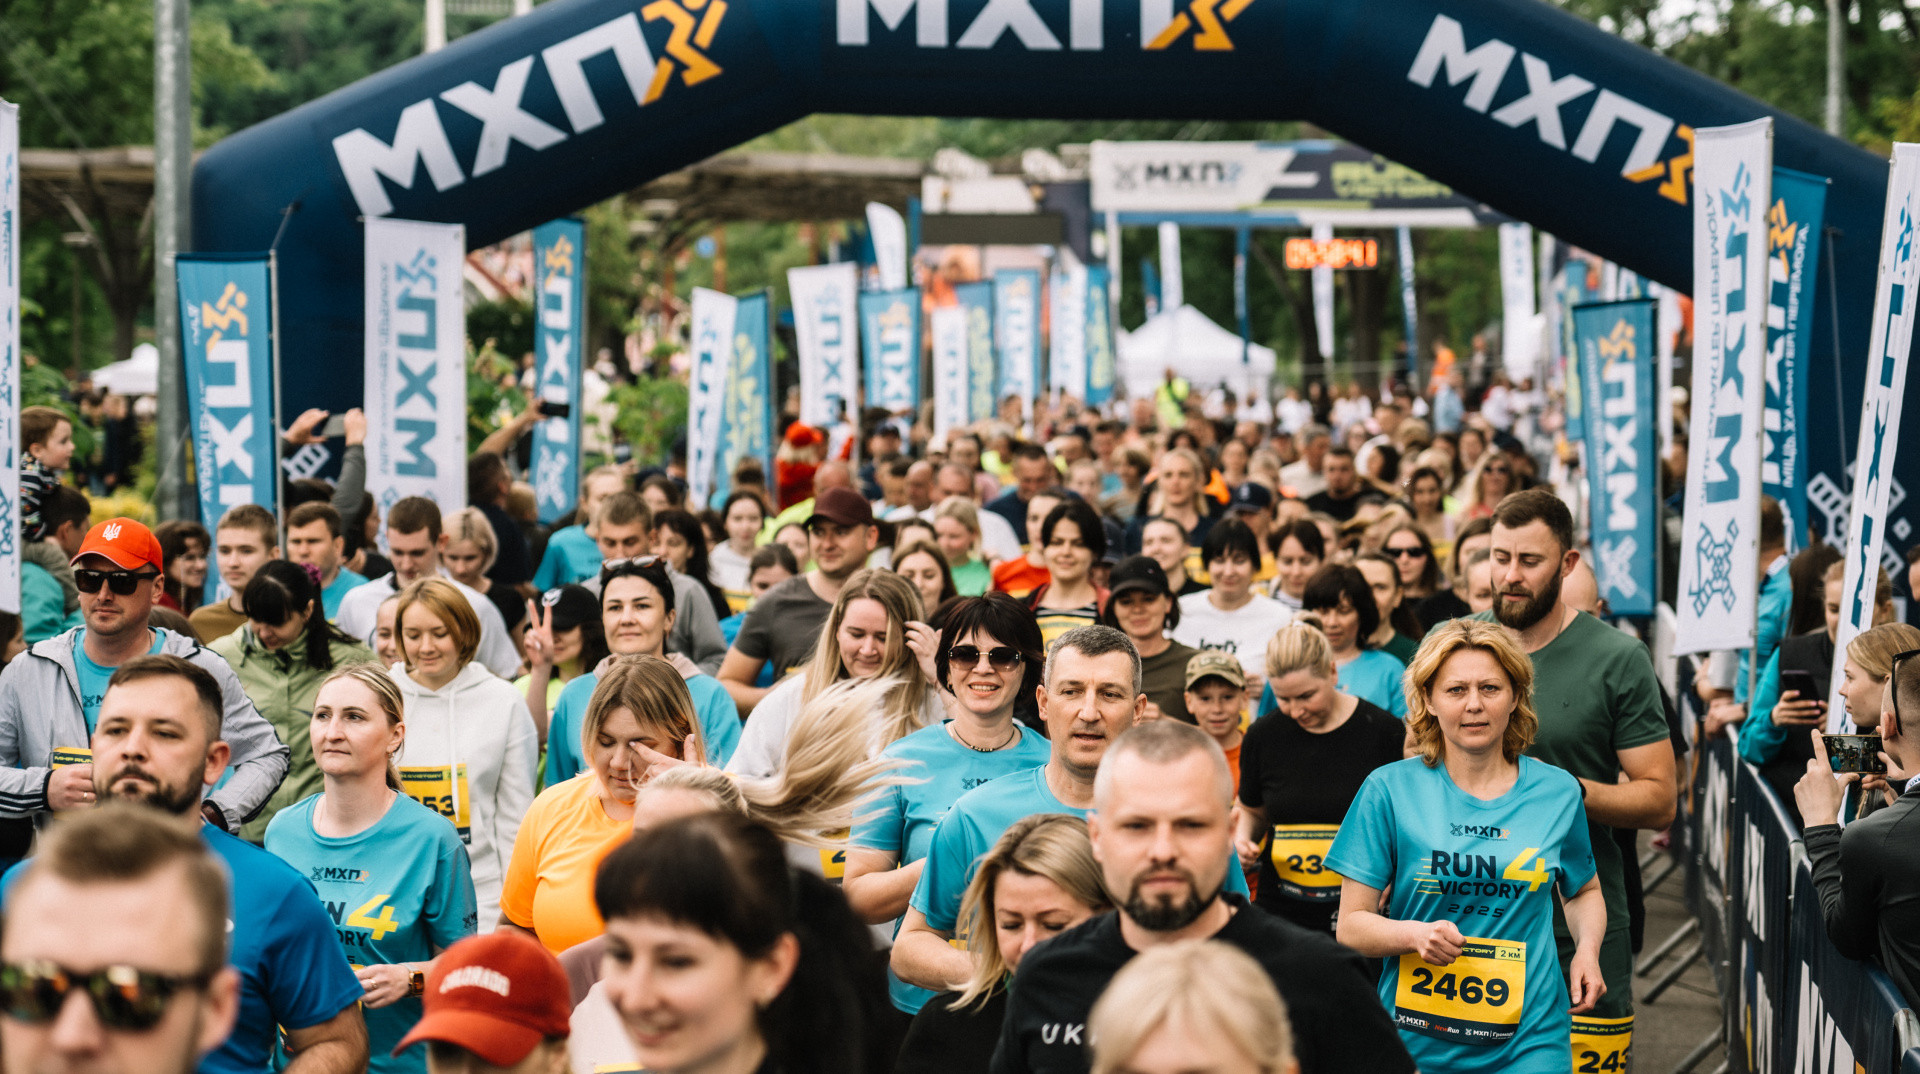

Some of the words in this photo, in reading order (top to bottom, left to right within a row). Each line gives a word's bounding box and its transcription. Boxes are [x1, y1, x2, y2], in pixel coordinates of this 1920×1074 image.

[1406, 12, 1676, 178] МХП
[332, 11, 657, 216] МХП
[1464, 825, 1501, 838] МХП
[324, 867, 361, 881] МХП
[1430, 849, 1497, 880] RUN
[1502, 847, 1550, 893] 4
[1438, 879, 1526, 900] VICTORY
[1500, 949, 1507, 958] 2
[1410, 966, 1510, 1007] 2469
